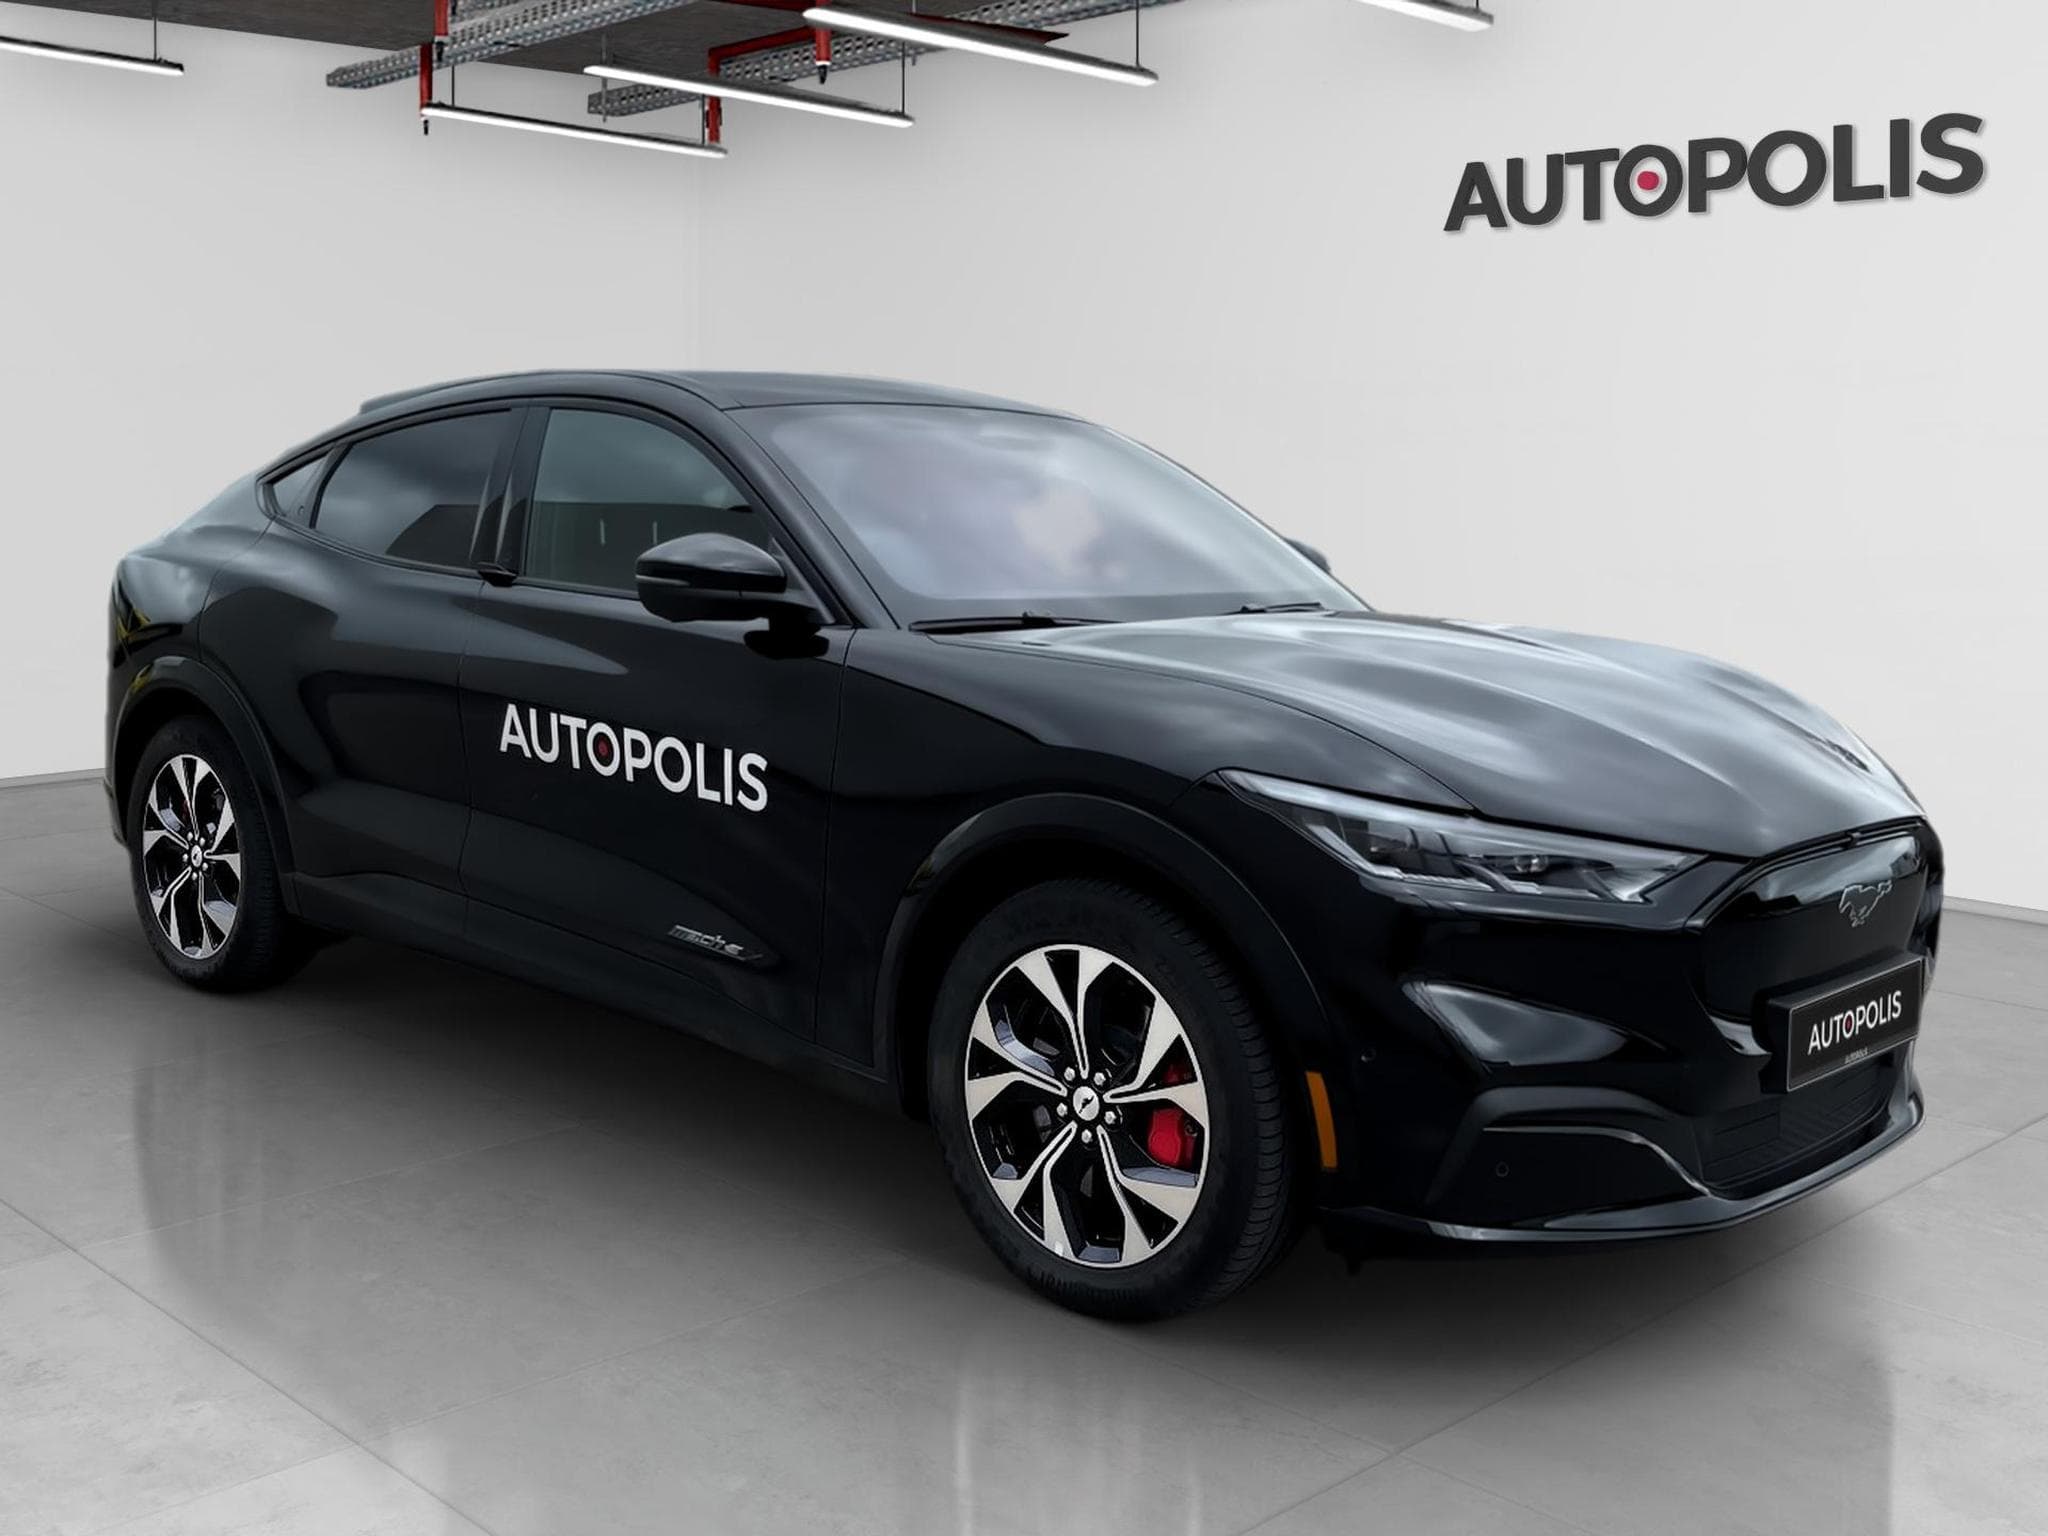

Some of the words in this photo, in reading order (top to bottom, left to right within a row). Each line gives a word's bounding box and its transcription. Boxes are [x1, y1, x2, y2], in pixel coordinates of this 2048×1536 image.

[1443, 112, 1984, 231] AUTOPOLIS
[499, 703, 769, 812] AUTOPOLIS
[1807, 990, 1902, 1055] AUTOPOLIS
